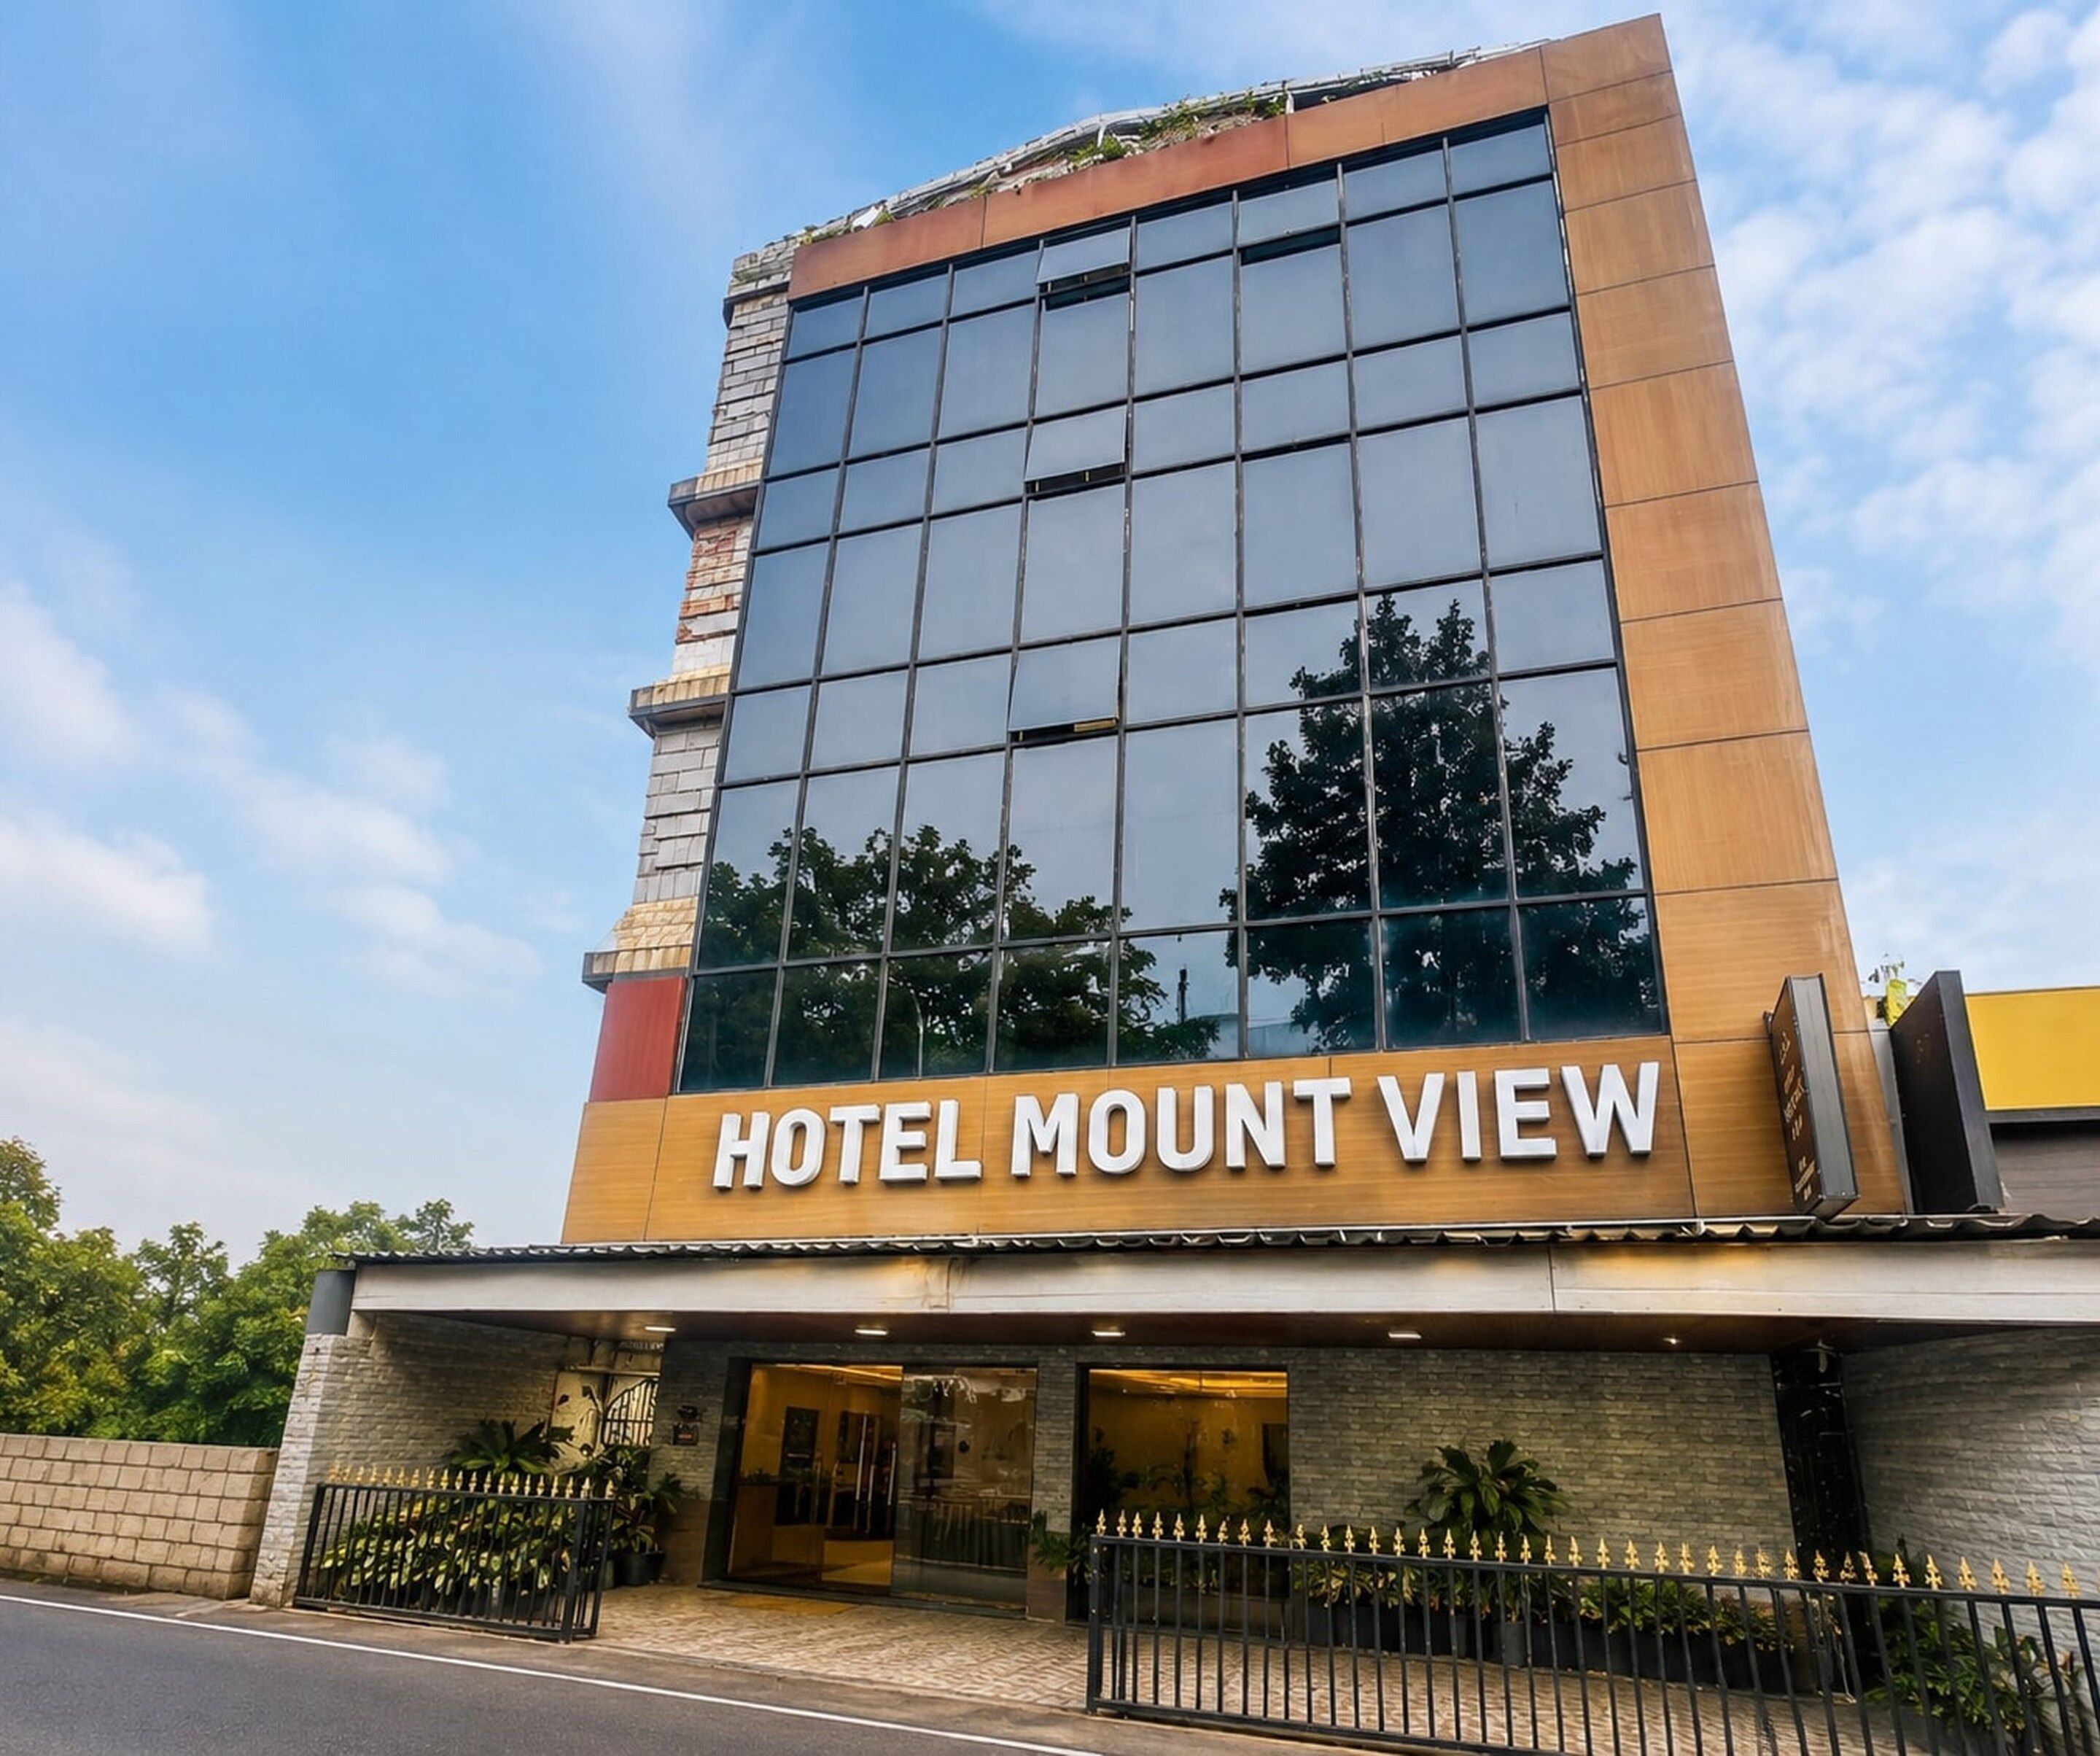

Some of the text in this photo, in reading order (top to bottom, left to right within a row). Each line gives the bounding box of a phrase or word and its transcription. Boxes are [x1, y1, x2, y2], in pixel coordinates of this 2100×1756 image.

[713, 1062, 1660, 1188] HOTEL MOUNT VIEW
